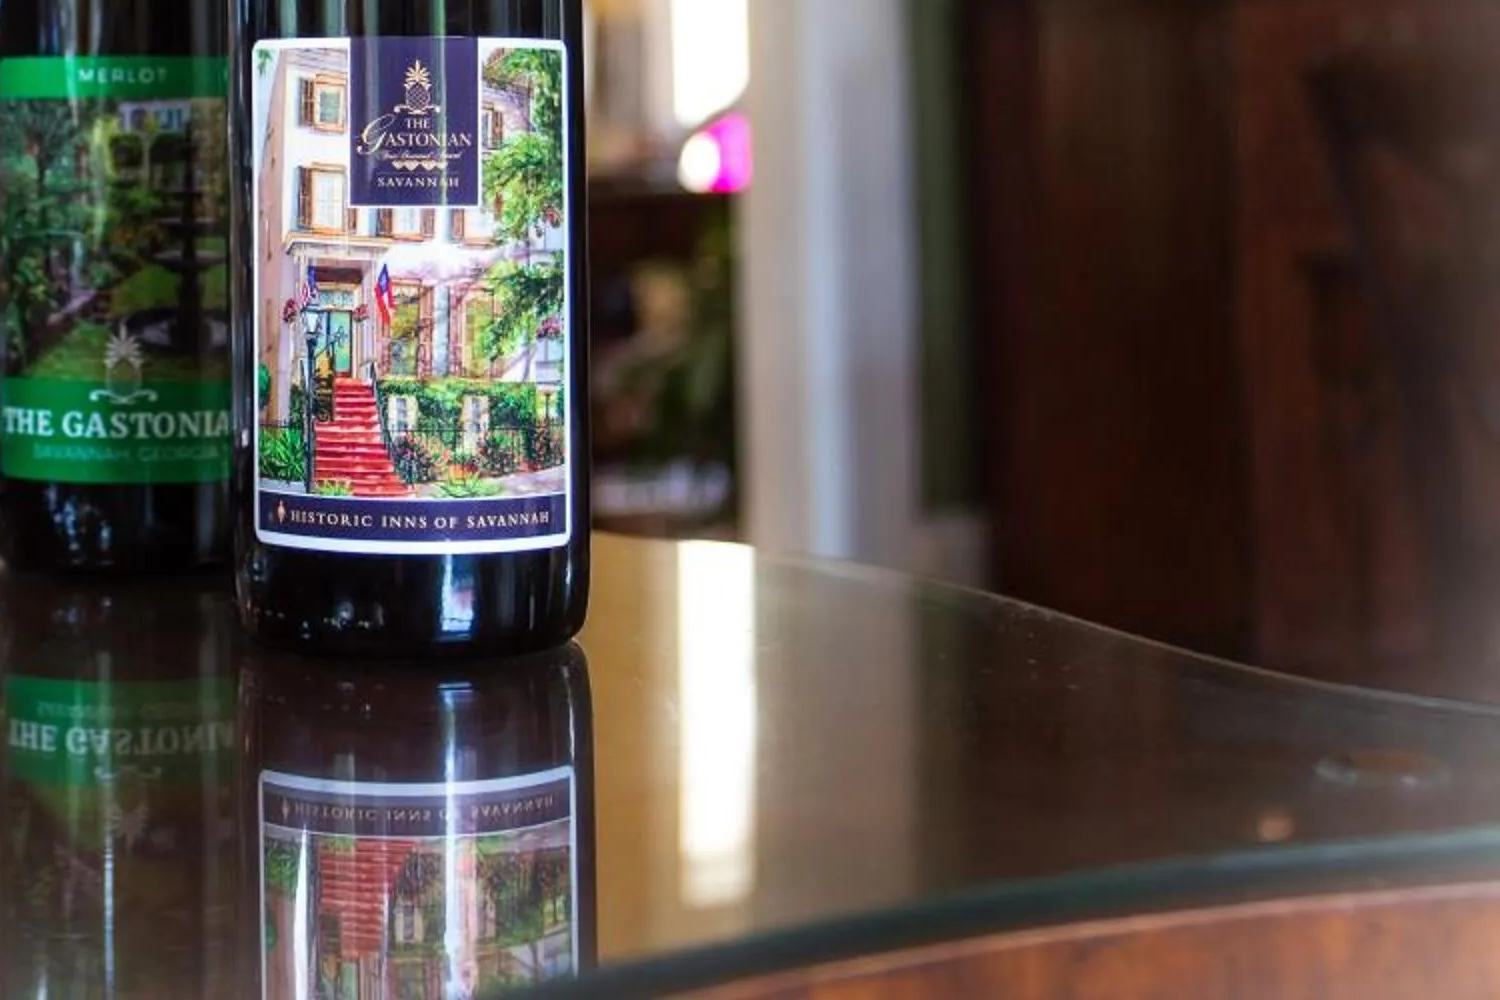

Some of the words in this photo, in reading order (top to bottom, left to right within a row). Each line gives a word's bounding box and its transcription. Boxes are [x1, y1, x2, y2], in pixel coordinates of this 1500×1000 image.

[77, 67, 168, 84] MERLOT
[404, 117, 431, 129] THE
[356, 113, 472, 155] GASTONIAN
[376, 176, 460, 188] SAVANNAH
[3, 406, 54, 437] THE
[61, 409, 237, 440] GASTONIA
[291, 508, 373, 528] HISTORIC
[382, 515, 428, 529] INNS
[433, 516, 459, 530] OF
[467, 510, 550, 529] SAVANNAH
